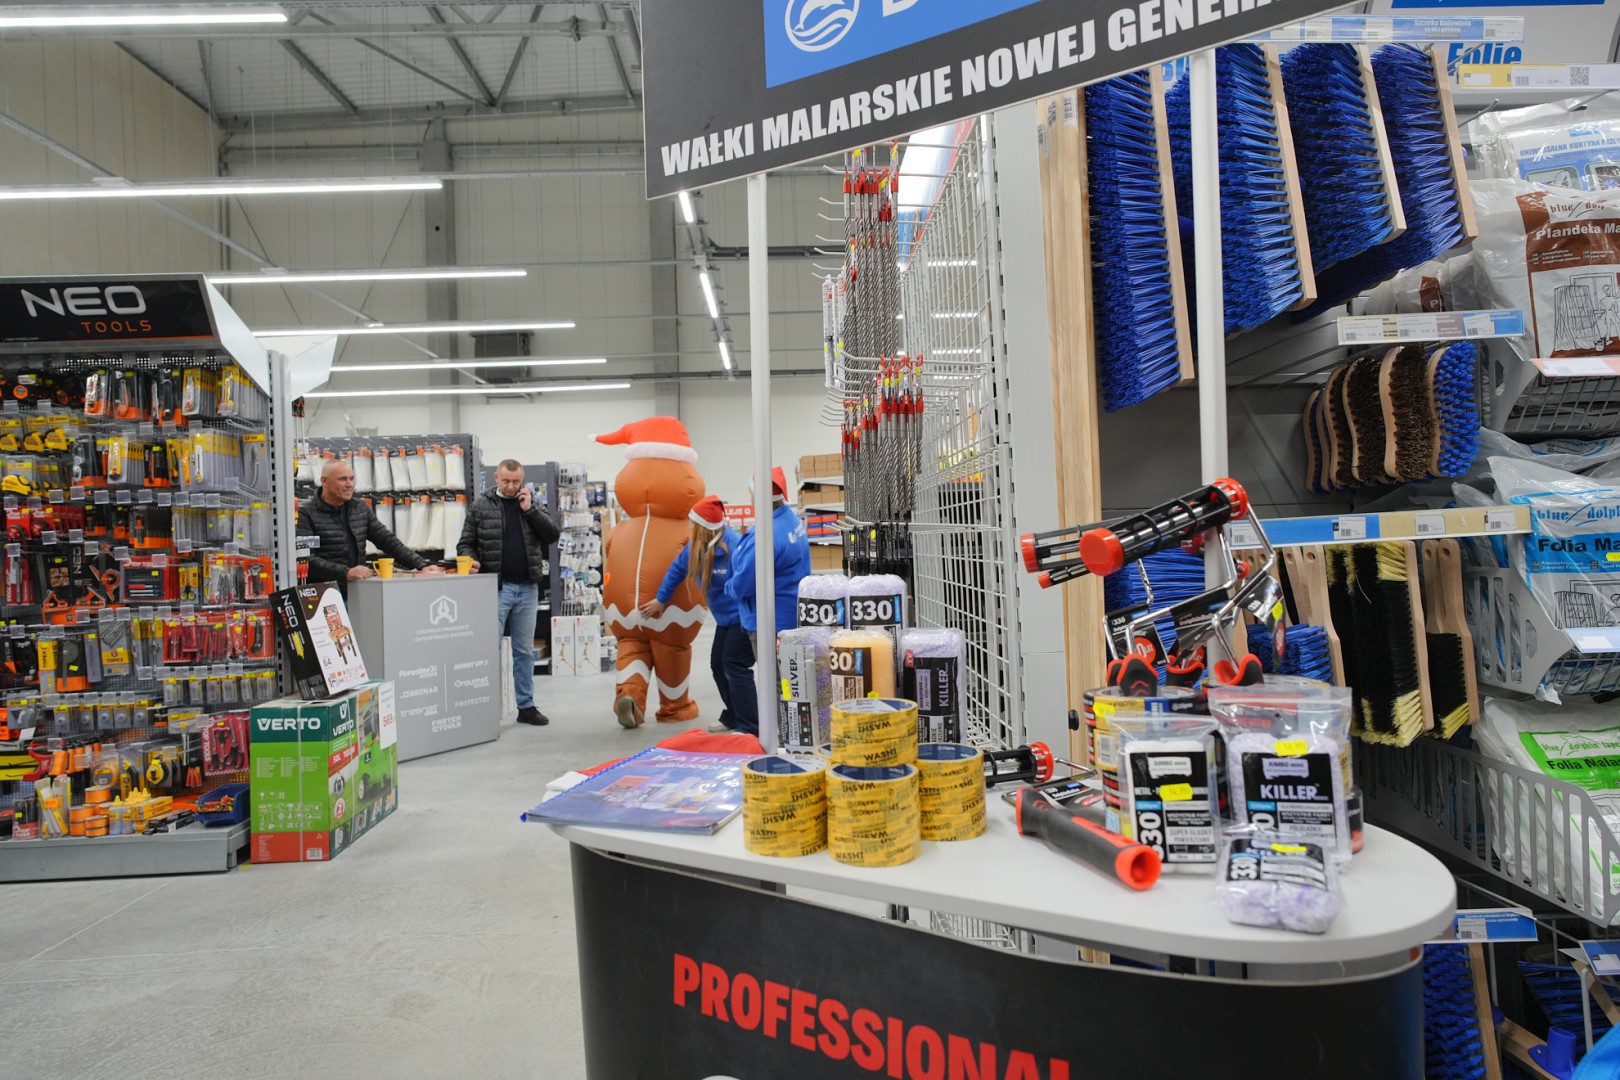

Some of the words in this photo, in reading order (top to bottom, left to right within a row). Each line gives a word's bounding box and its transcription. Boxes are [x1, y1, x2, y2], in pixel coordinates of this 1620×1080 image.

[661, 122, 754, 177] WAŁKI
[762, 65, 953, 151] MALARSKIE
[961, 19, 1096, 97] NOWEJ
[1107, 0, 1275, 52] GENE
[1536, 223, 1601, 241] Plandeka
[20, 285, 146, 317] NEO
[80, 319, 152, 333] TOOLS
[1538, 538, 1588, 553] Folia
[281, 594, 299, 628] NEO
[851, 600, 893, 621] 330
[938, 669, 950, 707] KILLER
[257, 717, 321, 731] VERTO
[332, 719, 354, 737] VERTO
[864, 748, 898, 761] WASHI
[1546, 760, 1583, 770] Folia
[1260, 783, 1319, 800] KILLER
